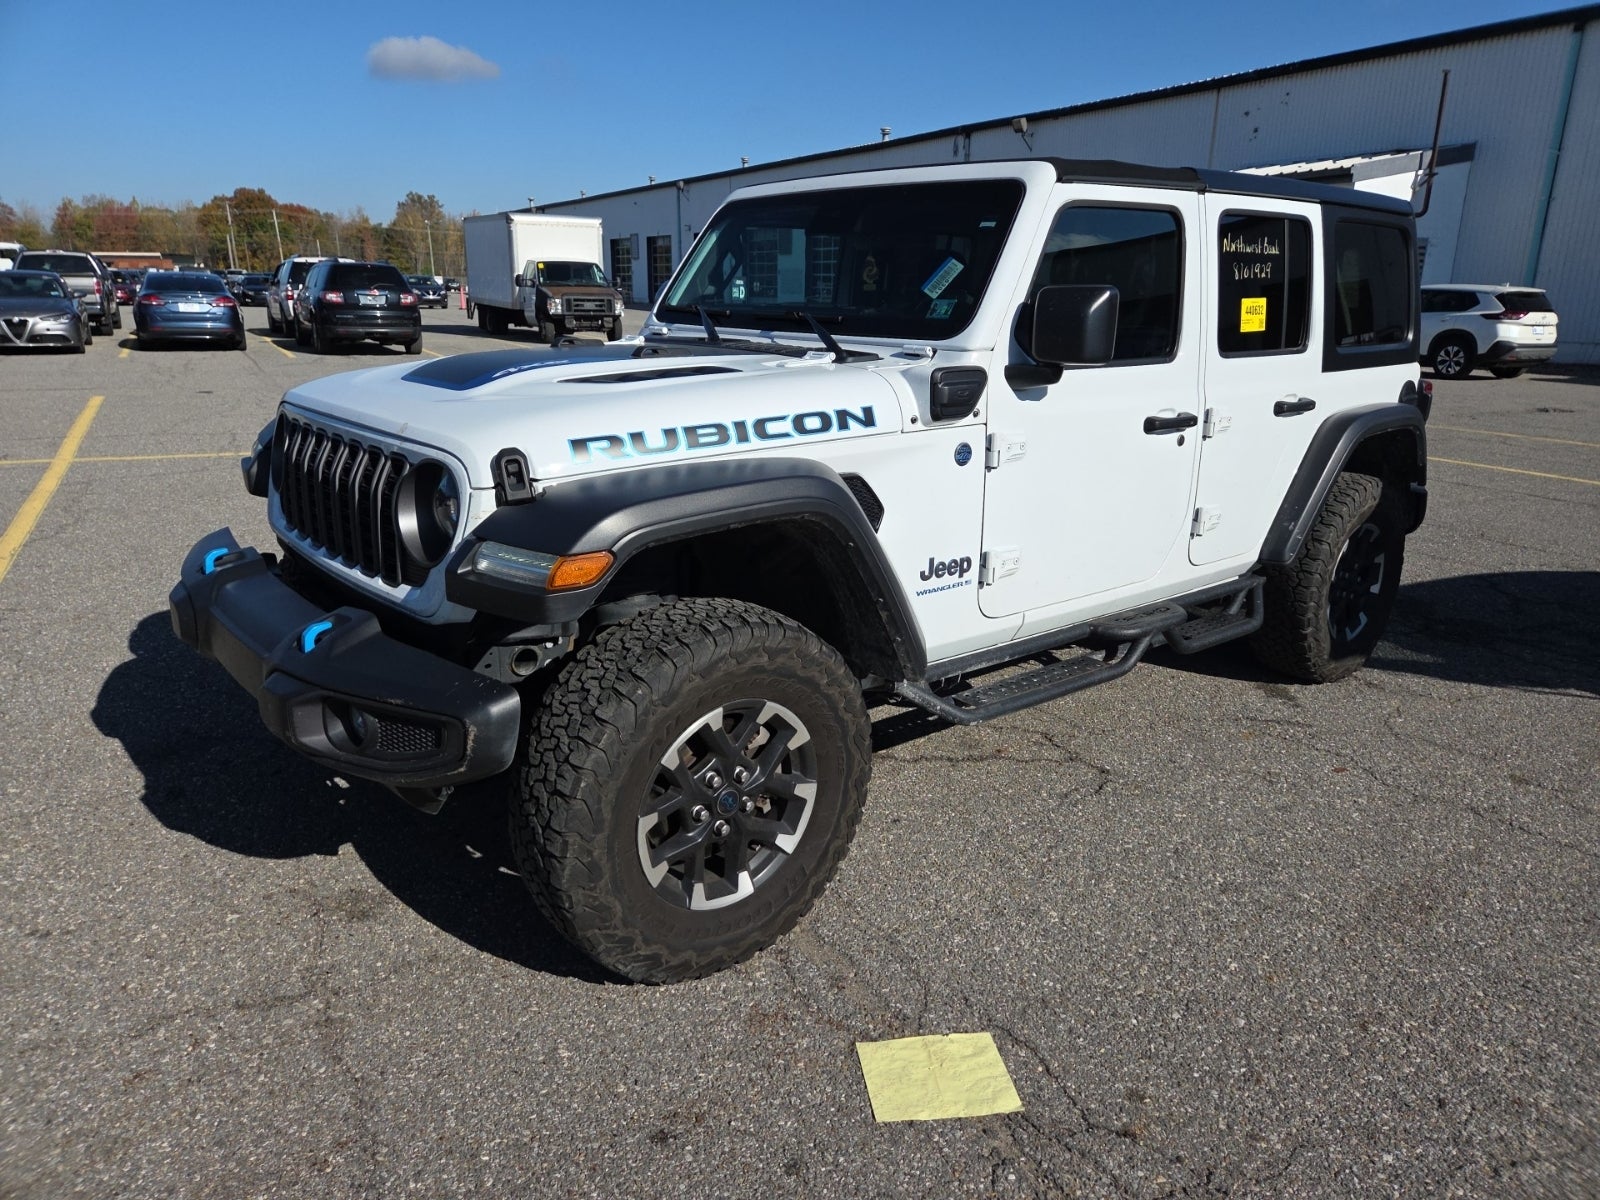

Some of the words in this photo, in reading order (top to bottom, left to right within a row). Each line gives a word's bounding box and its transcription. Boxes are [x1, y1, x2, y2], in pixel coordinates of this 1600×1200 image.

[1223, 232, 1262, 254] Northwest
[567, 405, 878, 463] RUBICON
[920, 556, 972, 582] Jeep
[916, 581, 964, 597] WRANGLER
